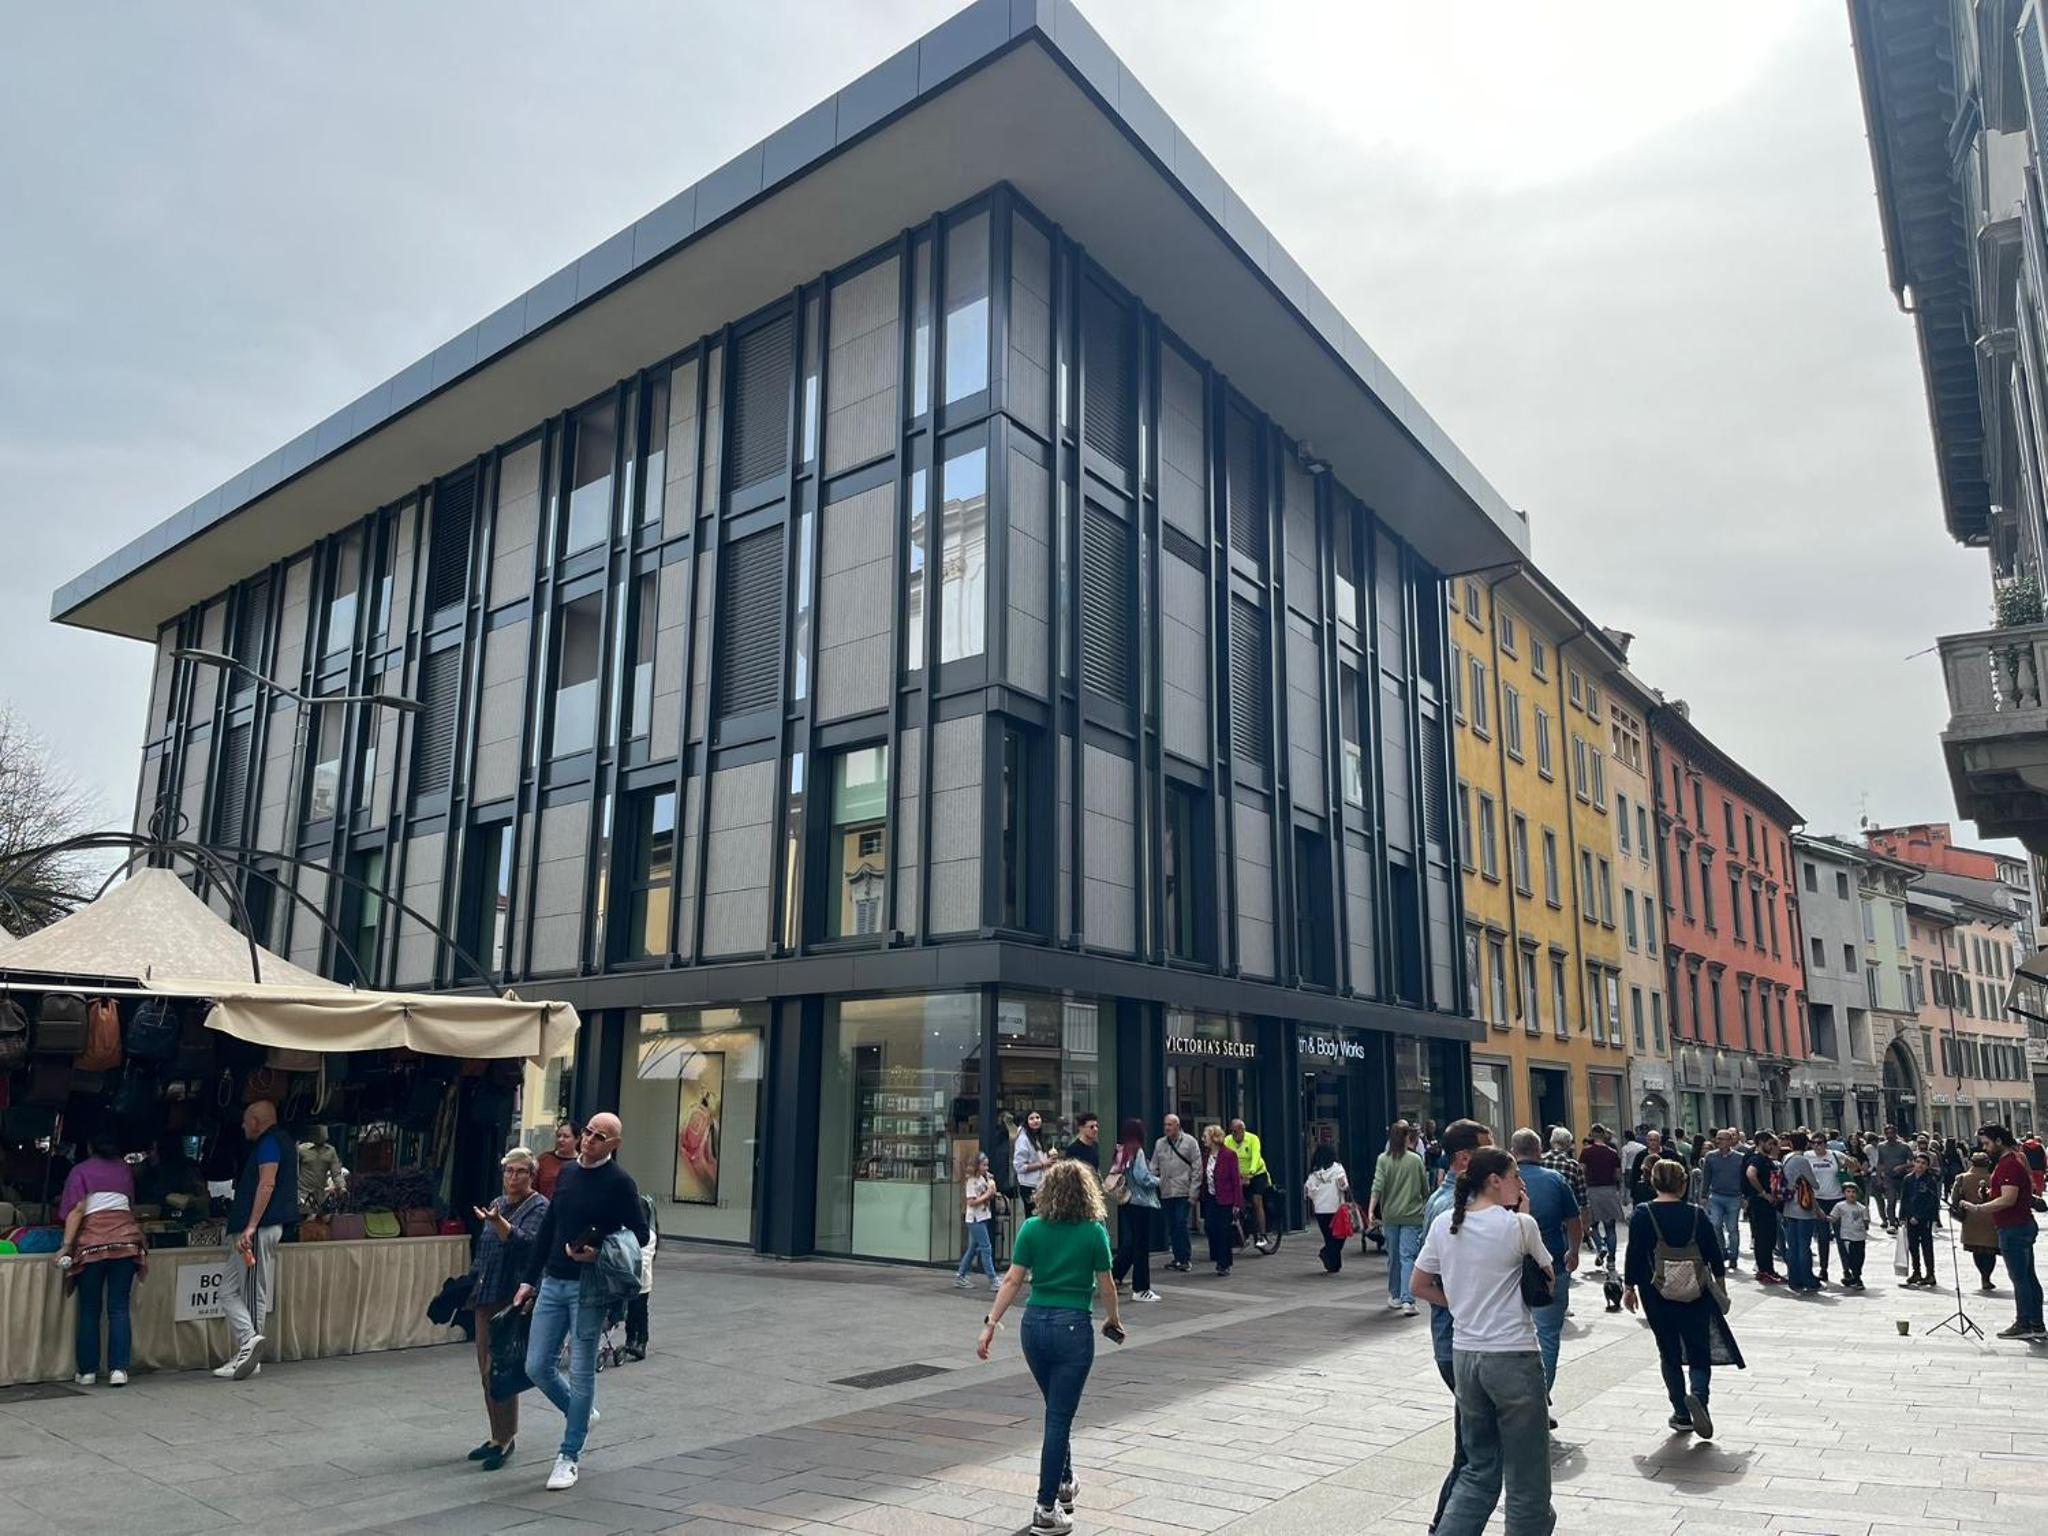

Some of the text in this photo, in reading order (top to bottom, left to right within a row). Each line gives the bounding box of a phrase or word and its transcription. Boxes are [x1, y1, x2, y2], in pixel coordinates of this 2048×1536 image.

[1166, 1035, 1256, 1058] VICTORIA'S SECRET
[1308, 1036, 1315, 1055] &
[1317, 1037, 1339, 1060] Body
[1340, 1040, 1365, 1059] Works
[200, 1273, 222, 1288] BO
[191, 1292, 208, 1306] IN
